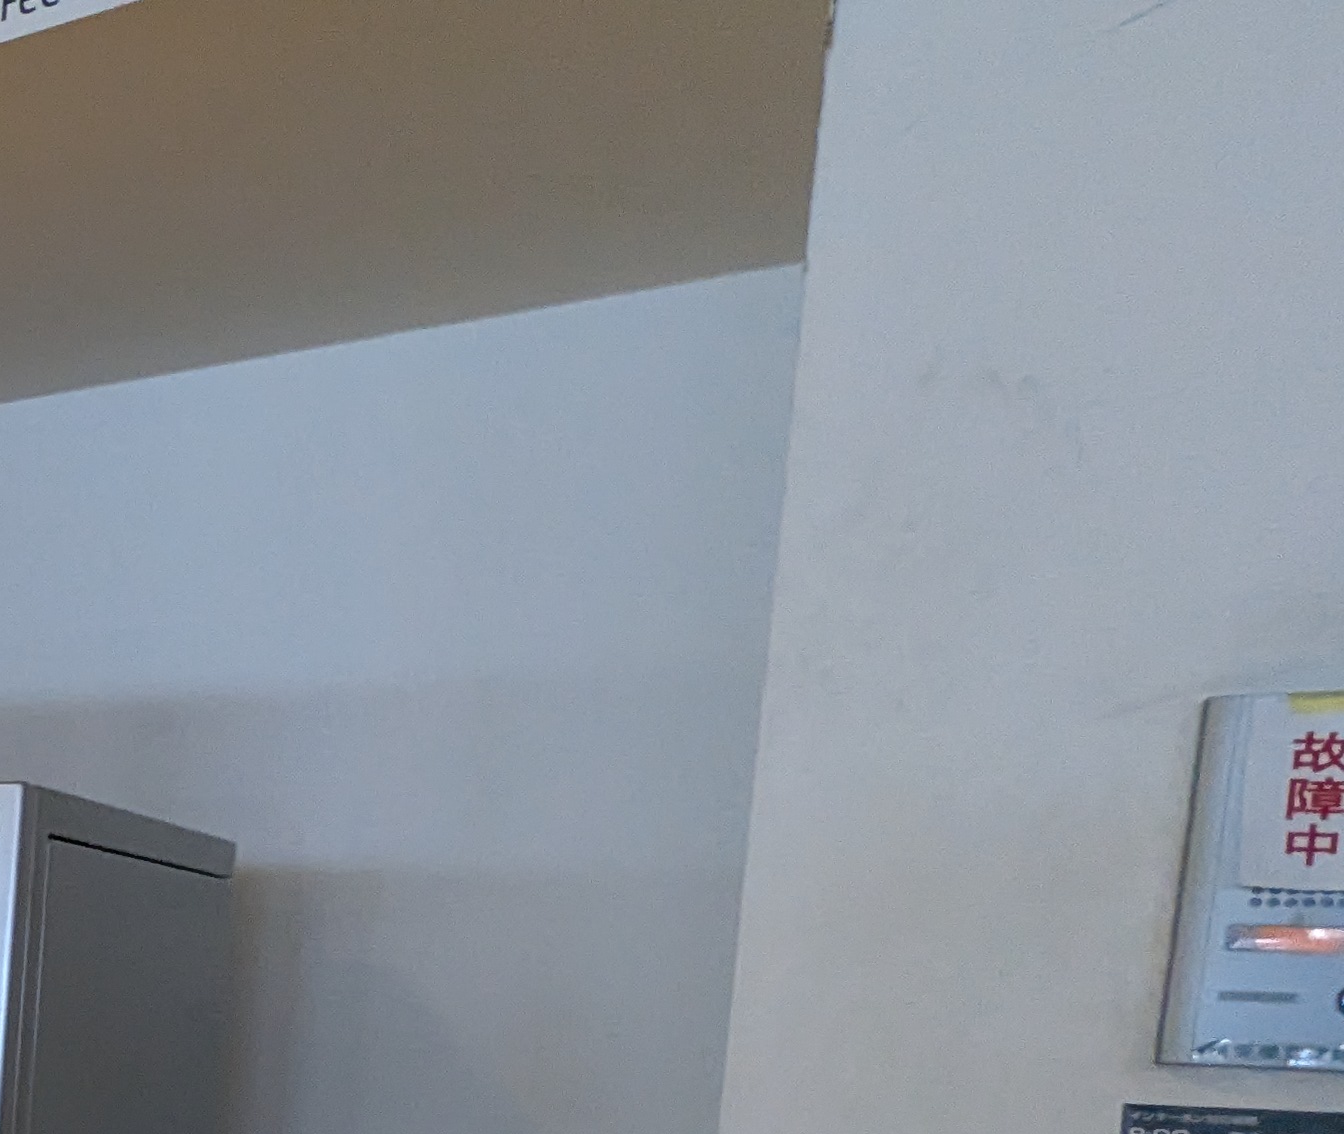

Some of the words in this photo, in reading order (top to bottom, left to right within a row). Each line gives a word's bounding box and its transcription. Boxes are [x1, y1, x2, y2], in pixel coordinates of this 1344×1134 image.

[1, 0, 60, 21] Fe
[1285, 731, 1344, 866] 故障中
